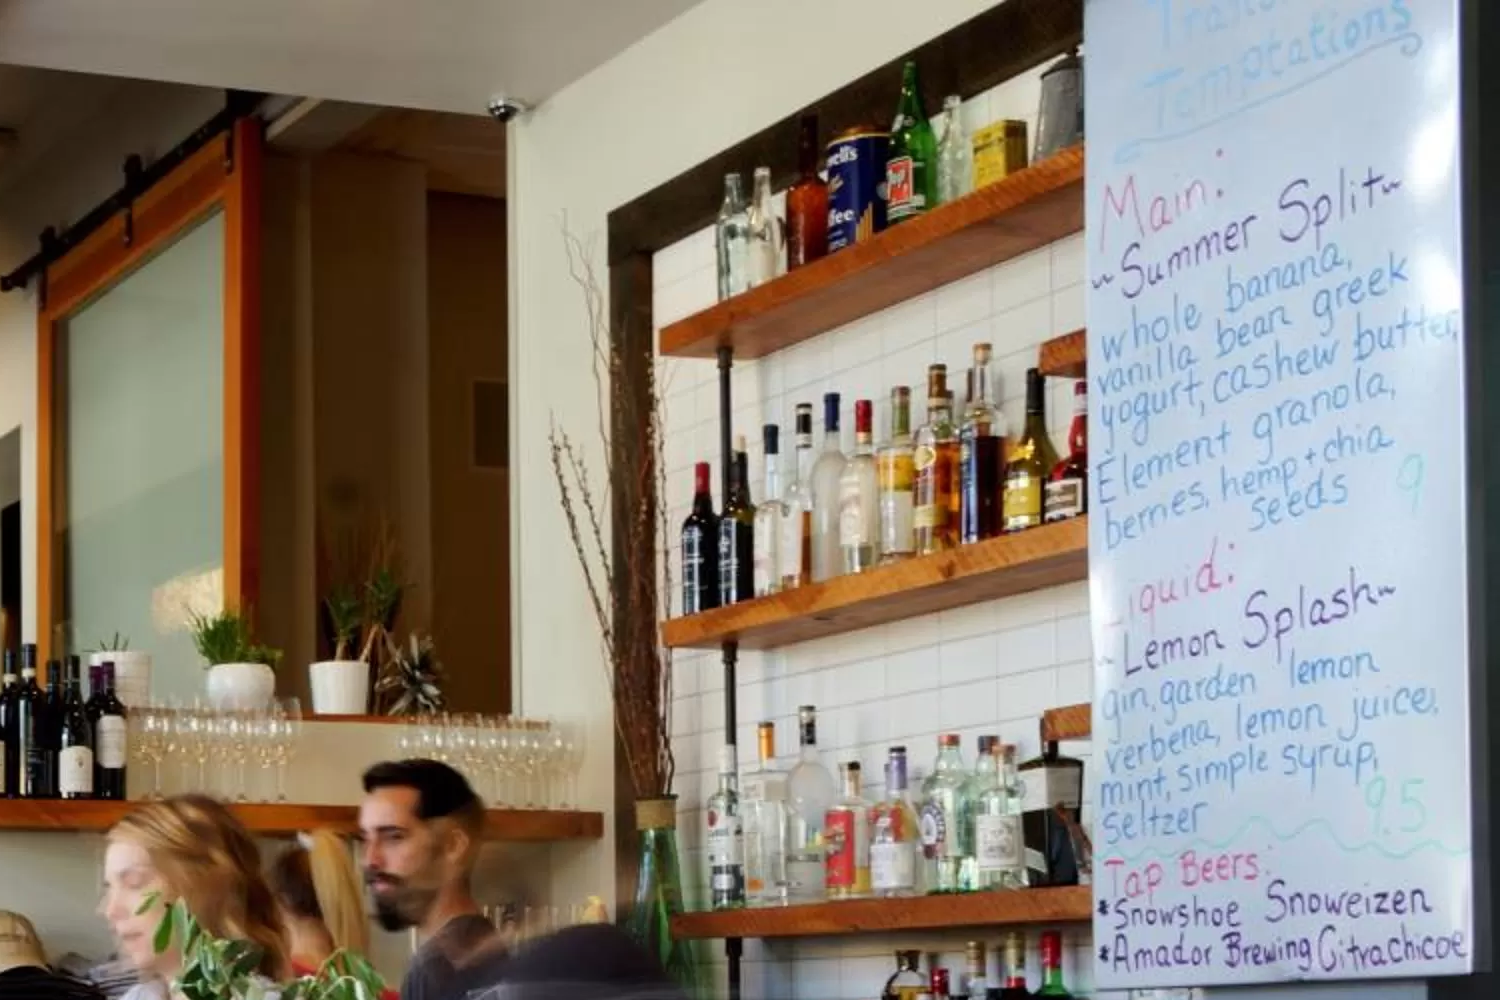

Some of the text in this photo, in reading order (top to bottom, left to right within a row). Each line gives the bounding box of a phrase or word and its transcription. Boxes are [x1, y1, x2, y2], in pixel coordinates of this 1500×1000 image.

[1100, 149, 1223, 252] Main:
[1097, 252, 1408, 396] vanilla bean greek
[1102, 241, 1353, 363] whole banana,
[1212, 338, 1341, 407] cashew
[1095, 421, 1232, 504] Element
[1253, 369, 1396, 465] granola,
[1220, 452, 1297, 500] hemp
[1323, 424, 1394, 466] chia
[1249, 469, 1349, 532] seeds
[1161, 663, 1257, 726] garden
[1289, 646, 1381, 688] lemon
[1105, 716, 1221, 776] verbena,
[1235, 704, 1327, 743] lemon
[1179, 743, 1268, 794] simple
[1102, 801, 1208, 845] seltzer
[1103, 859, 1163, 901] Tap
[1265, 879, 1432, 925] Snoweizen
[1222, 931, 1311, 973] Brewing
